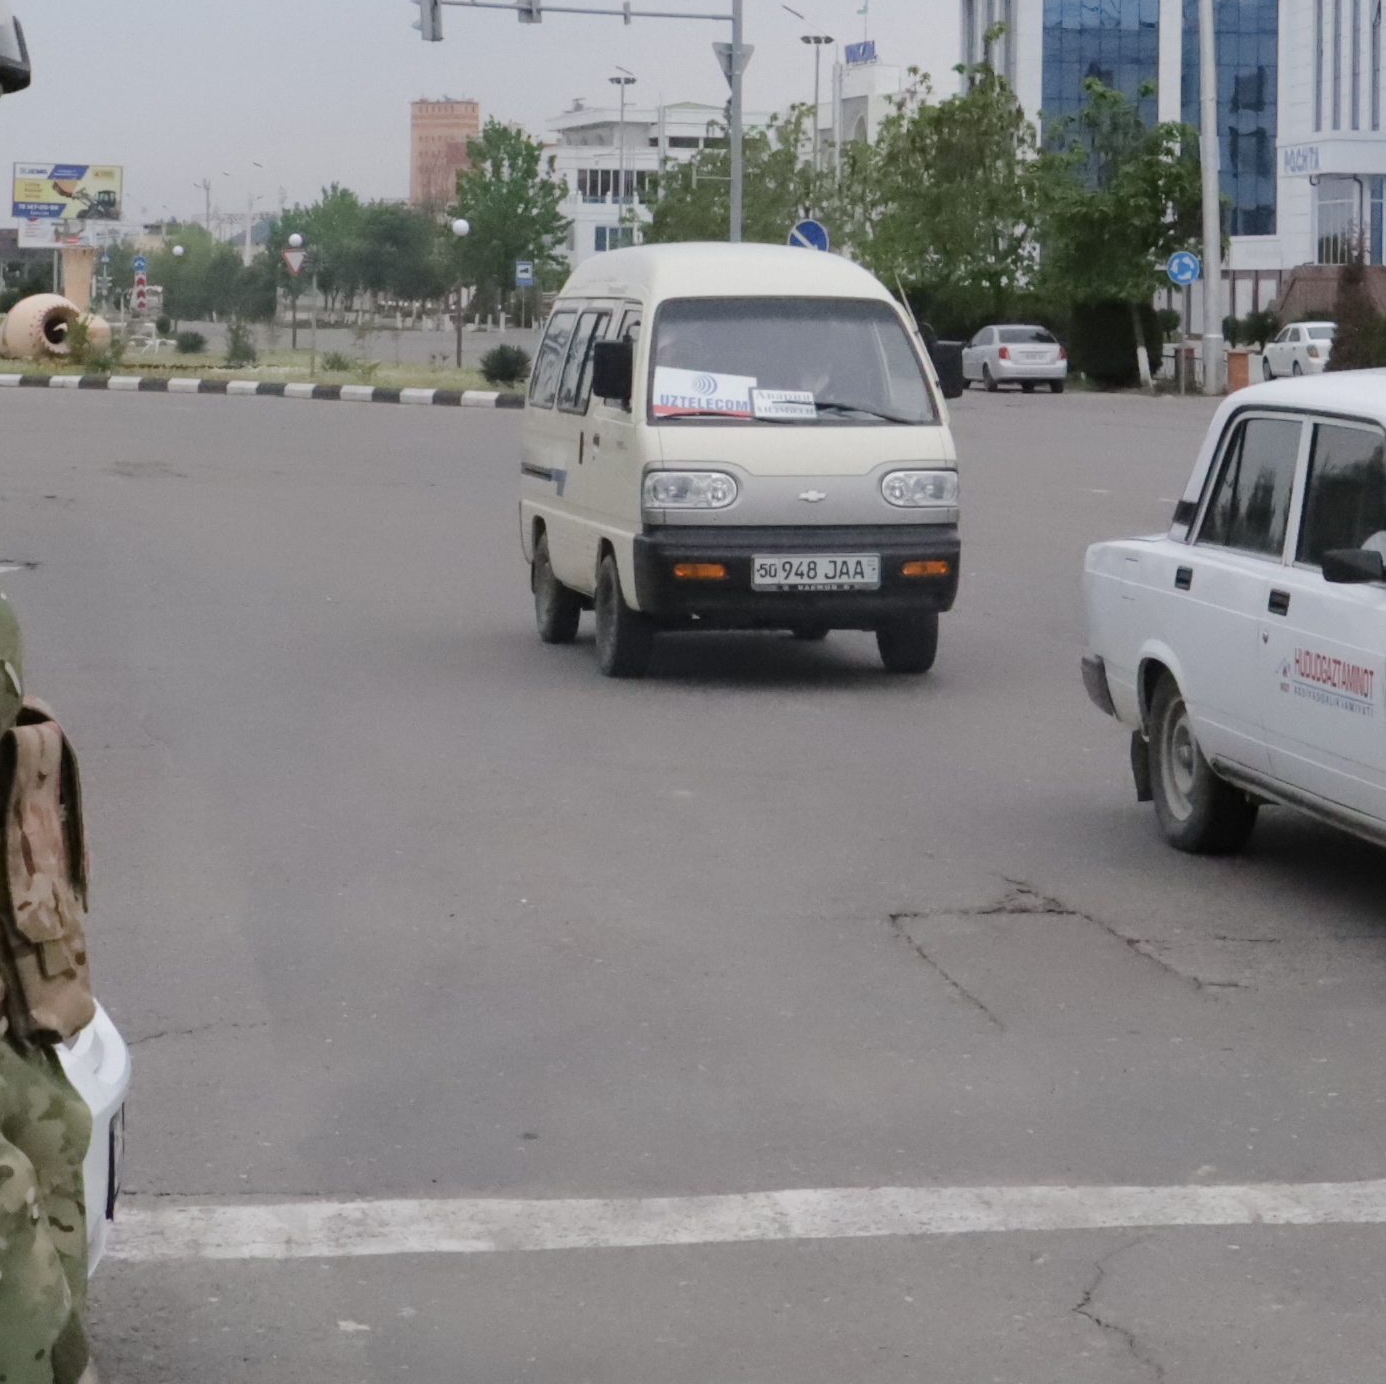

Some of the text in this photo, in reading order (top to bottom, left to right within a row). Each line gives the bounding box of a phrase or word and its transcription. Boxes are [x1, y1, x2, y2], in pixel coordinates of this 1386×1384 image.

[659, 394, 750, 412] UZTELECOM
[759, 560, 865, 580] 50 948 JAA
